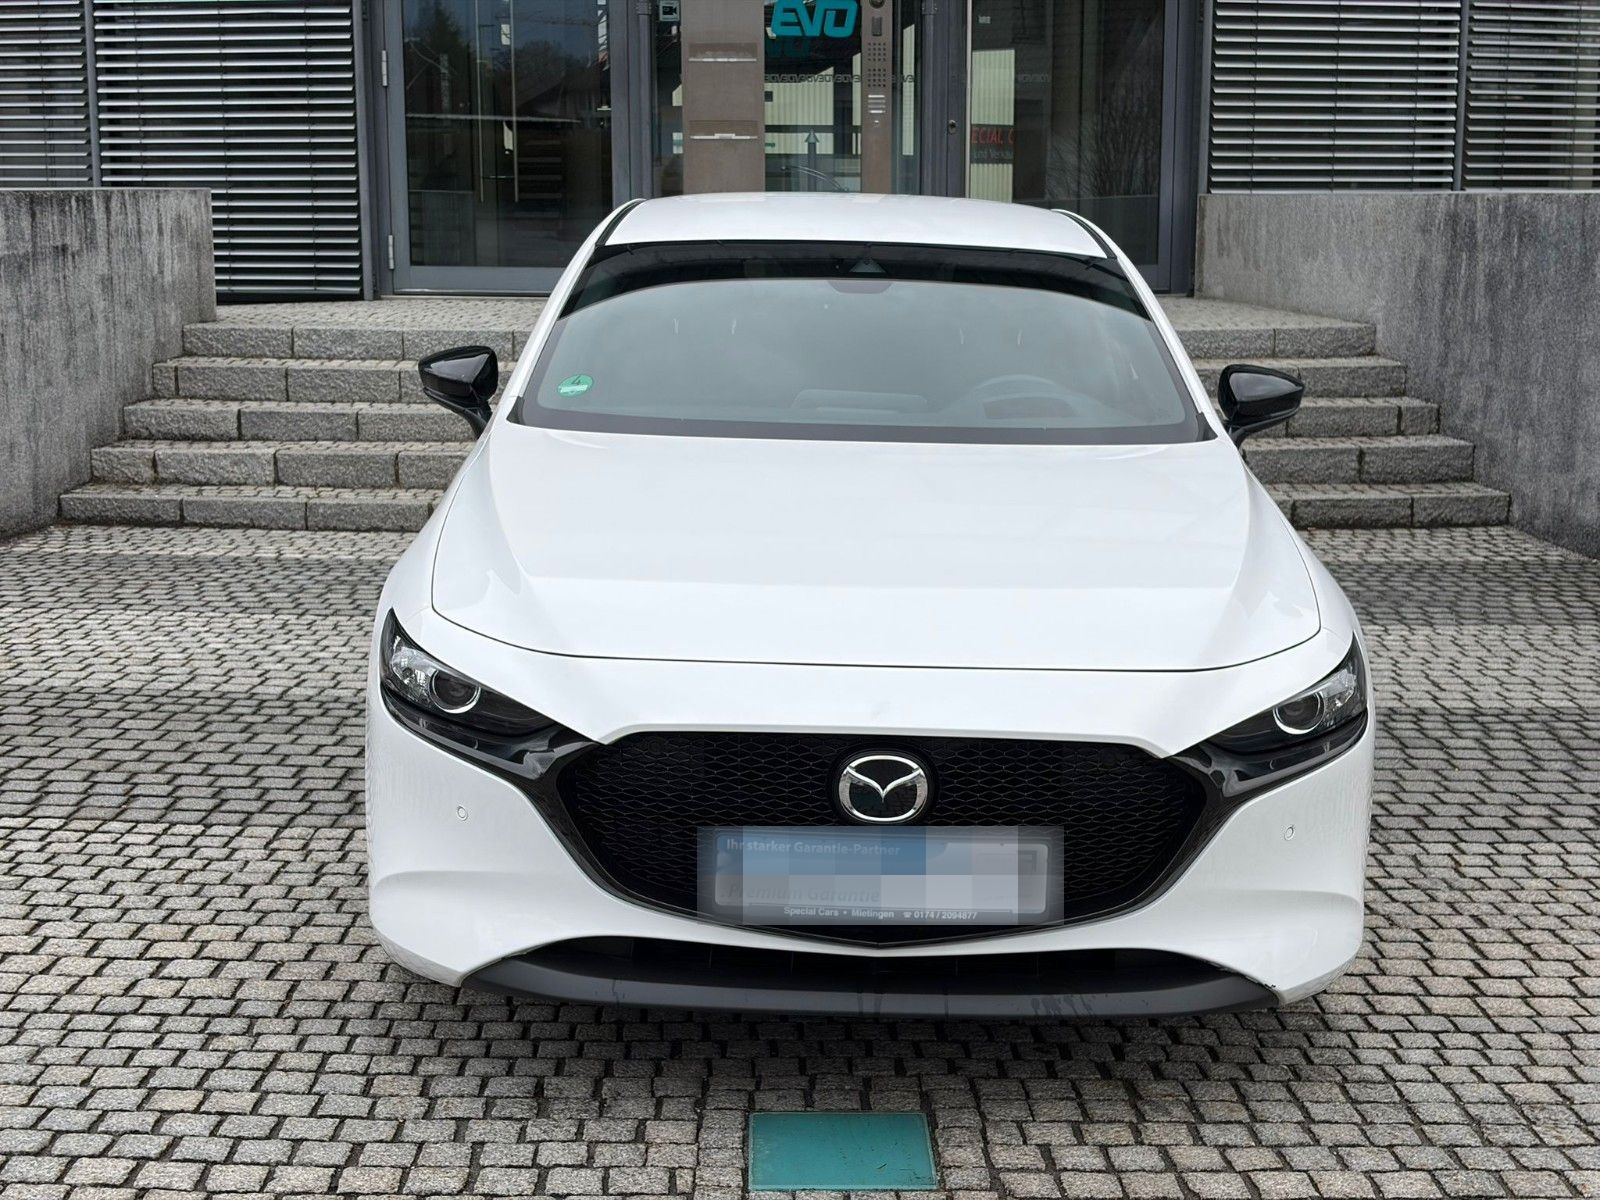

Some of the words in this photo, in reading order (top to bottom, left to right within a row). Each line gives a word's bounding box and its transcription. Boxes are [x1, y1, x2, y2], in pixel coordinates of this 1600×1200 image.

[771, 0, 858, 38] EVO
[726, 838, 744, 851] Ihr
[747, 840, 792, 852] starker
[793, 841, 901, 856] Garantie-Partner
[728, 882, 804, 900] Premium
[807, 886, 881, 903] Garantie
[783, 906, 816, 917] Special
[818, 907, 839, 916] Cars
[851, 909, 895, 920] Mietingen
